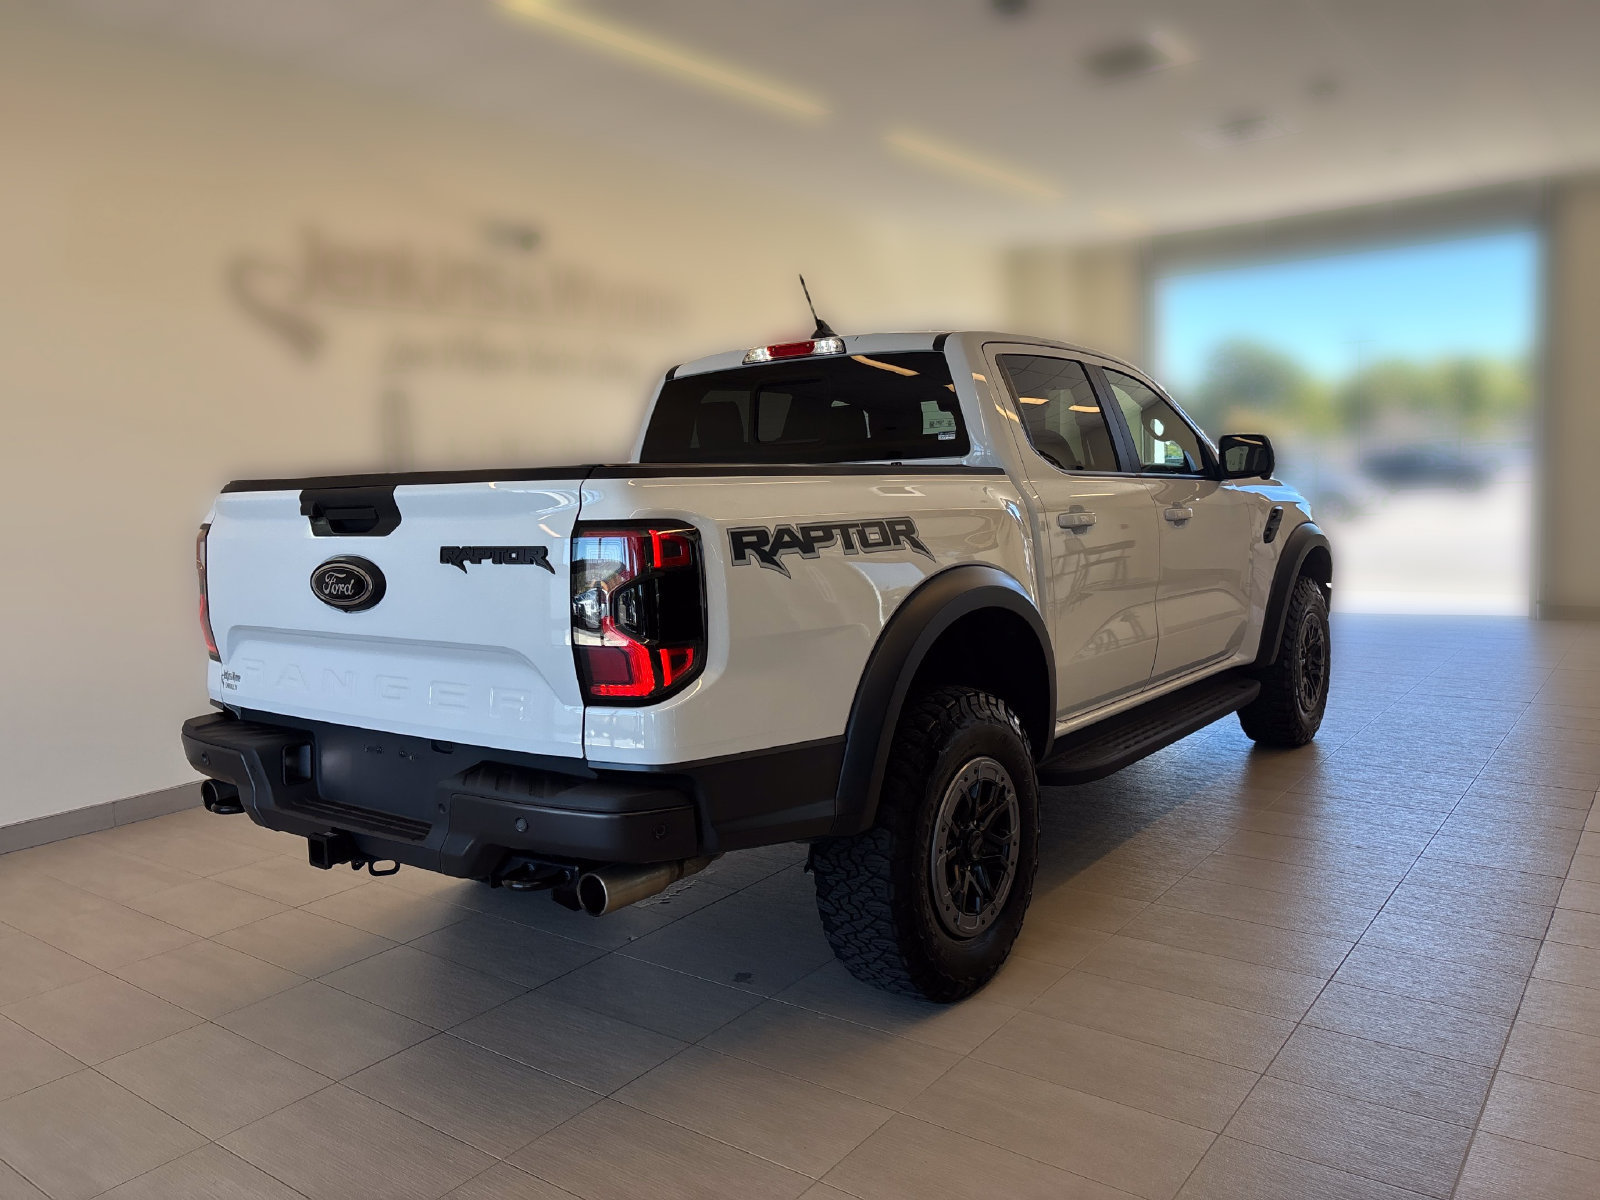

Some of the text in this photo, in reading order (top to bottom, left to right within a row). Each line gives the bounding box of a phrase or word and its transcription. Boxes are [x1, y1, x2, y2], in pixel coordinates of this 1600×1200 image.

[440, 545, 556, 575] RAPTOR
[726, 516, 936, 579] RAPTOR
[322, 571, 355, 595] Ford
[241, 657, 532, 722] RANGER
